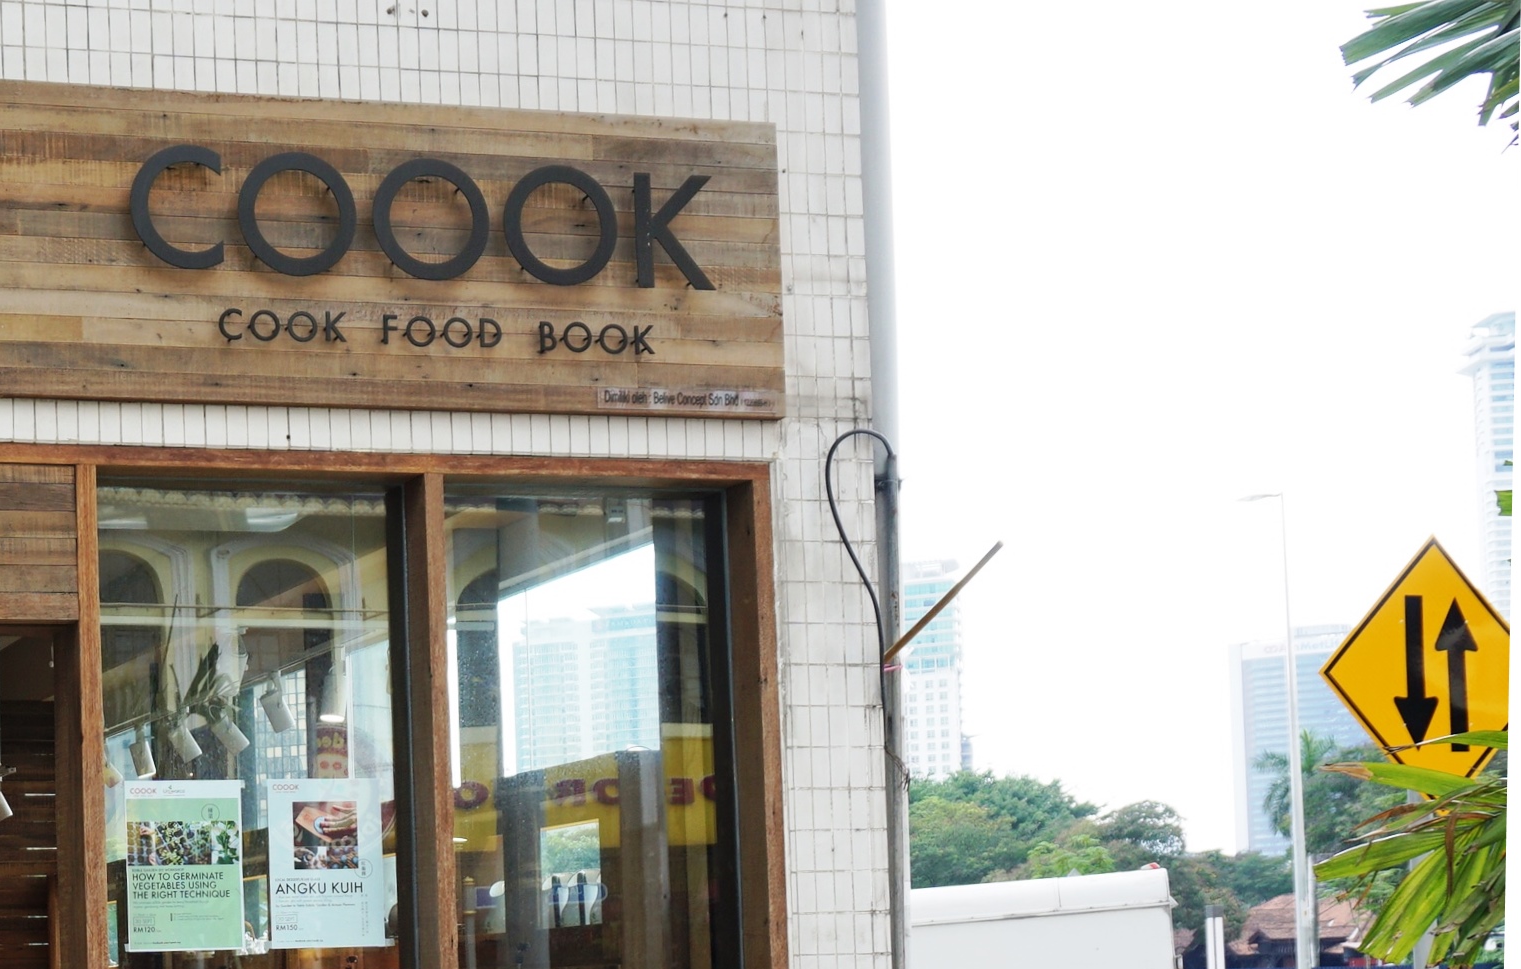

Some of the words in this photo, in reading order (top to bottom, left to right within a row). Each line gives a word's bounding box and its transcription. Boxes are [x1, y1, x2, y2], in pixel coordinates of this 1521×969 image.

[129, 144, 717, 291] COOOK
[218, 307, 348, 345] COOK
[380, 312, 502, 349] FOOD
[538, 320, 656, 355] BOOK
[132, 872, 155, 881] HOW
[158, 872, 171, 881] TO
[173, 871, 224, 881] GERMINATE
[132, 881, 186, 890] VEGETABLES
[188, 880, 217, 889] USING
[275, 882, 327, 895] ANGKU
[331, 881, 363, 894] KUIH
[132, 890, 148, 899] THE
[151, 890, 178, 899] RIGHT
[180, 889, 231, 899] TECHNIQUE
[275, 924, 298, 932] RM150
